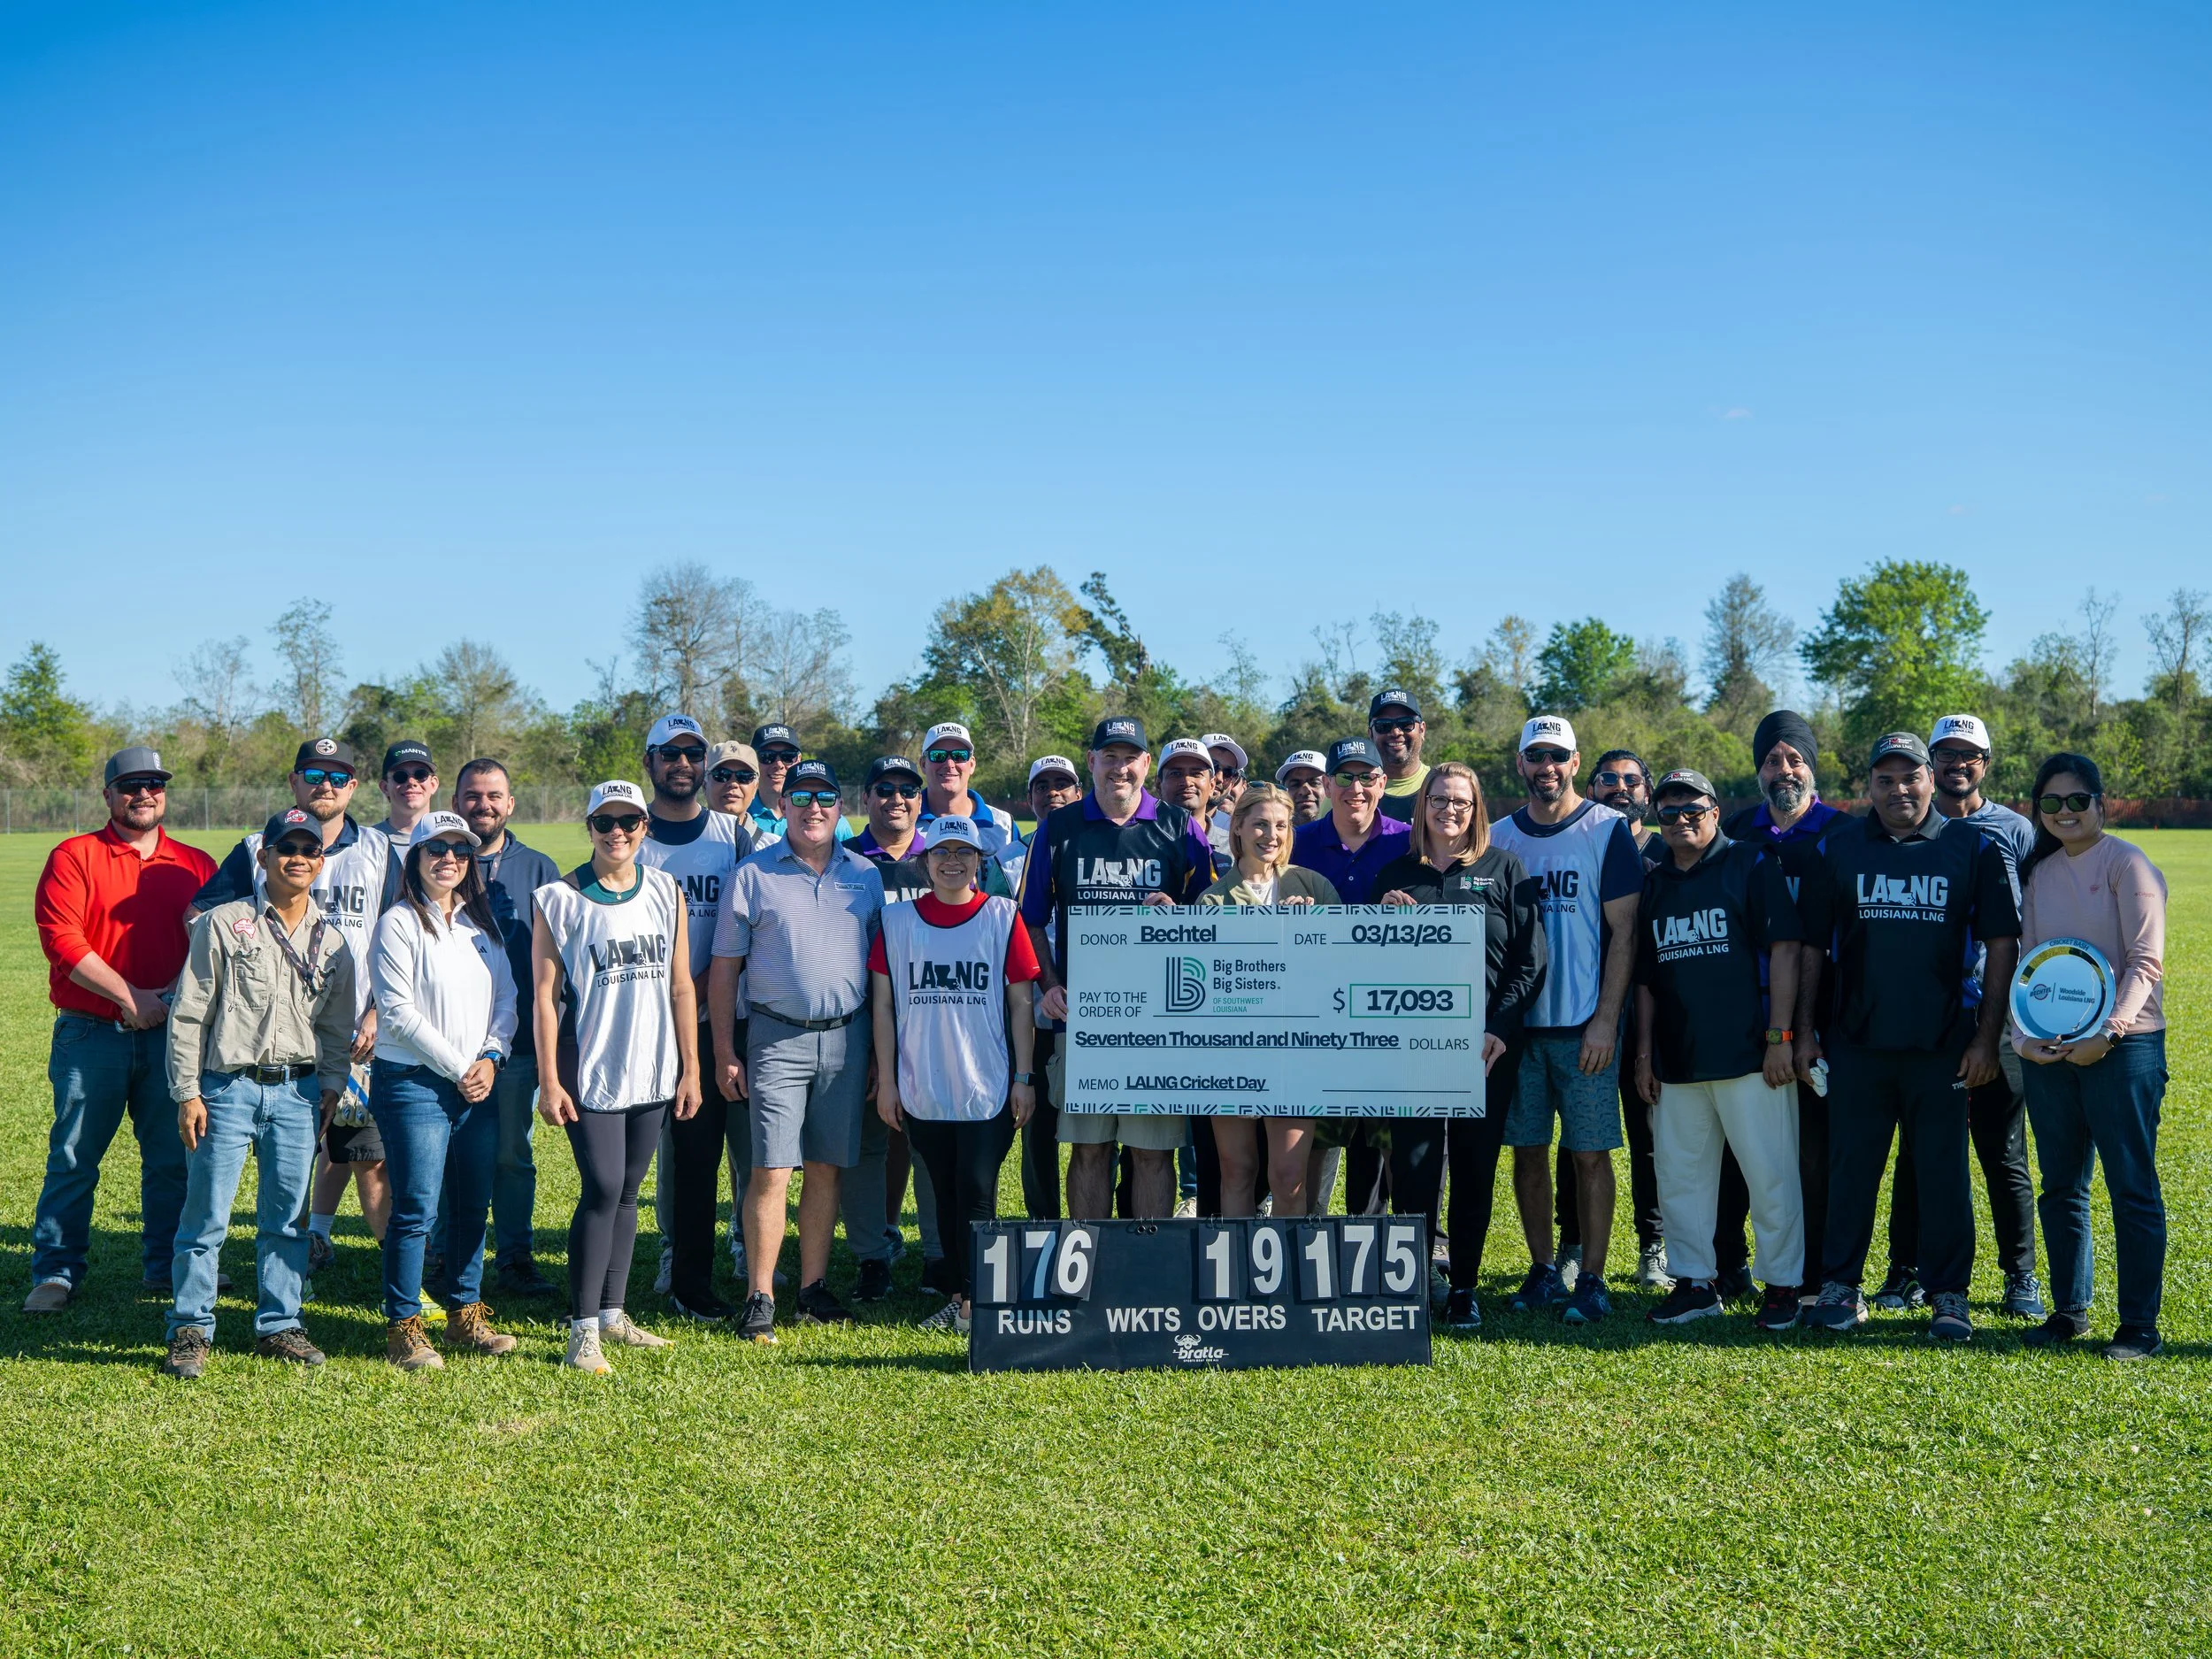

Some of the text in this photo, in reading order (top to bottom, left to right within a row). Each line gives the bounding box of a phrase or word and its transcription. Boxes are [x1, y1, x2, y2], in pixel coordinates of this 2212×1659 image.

[1078, 890, 1136, 901] LOUISIANA
[698, 909, 717, 918] LNG
[1556, 903, 1576, 914] LNG
[1859, 909, 1945, 922] LOUISIANA LNG
[344, 919, 363, 928] LNG
[1080, 925, 1217, 946] DONOR Bechtel
[1294, 924, 1452, 947] DATE 03/13/26
[2073, 940, 2090, 951] BASH
[1657, 943, 1730, 964] LOUISIANA LNG
[1213, 959, 1286, 975] Big Brothers
[597, 970, 649, 988] LOUISIANA
[1213, 977, 1233, 993] Big
[1079, 991, 1148, 1003] PAY TO THE
[2030, 987, 2052, 997] BECHTEL
[2059, 987, 2086, 996] Woodside
[909, 995, 987, 1006] LOUISIANA LNG
[1333, 987, 1454, 1015] $ 17,093
[2058, 994, 2083, 1002] Louisiana
[1079, 1006, 1141, 1018] ORDER OF
[1075, 1031, 1470, 1050] Seventeen Thousand and Ninety Three DOLLARS
[1078, 1075, 1266, 1093] MEMO LALNG Cricket Day
[998, 1304, 1420, 1334] RUNS WKTS OVERS TARGET
